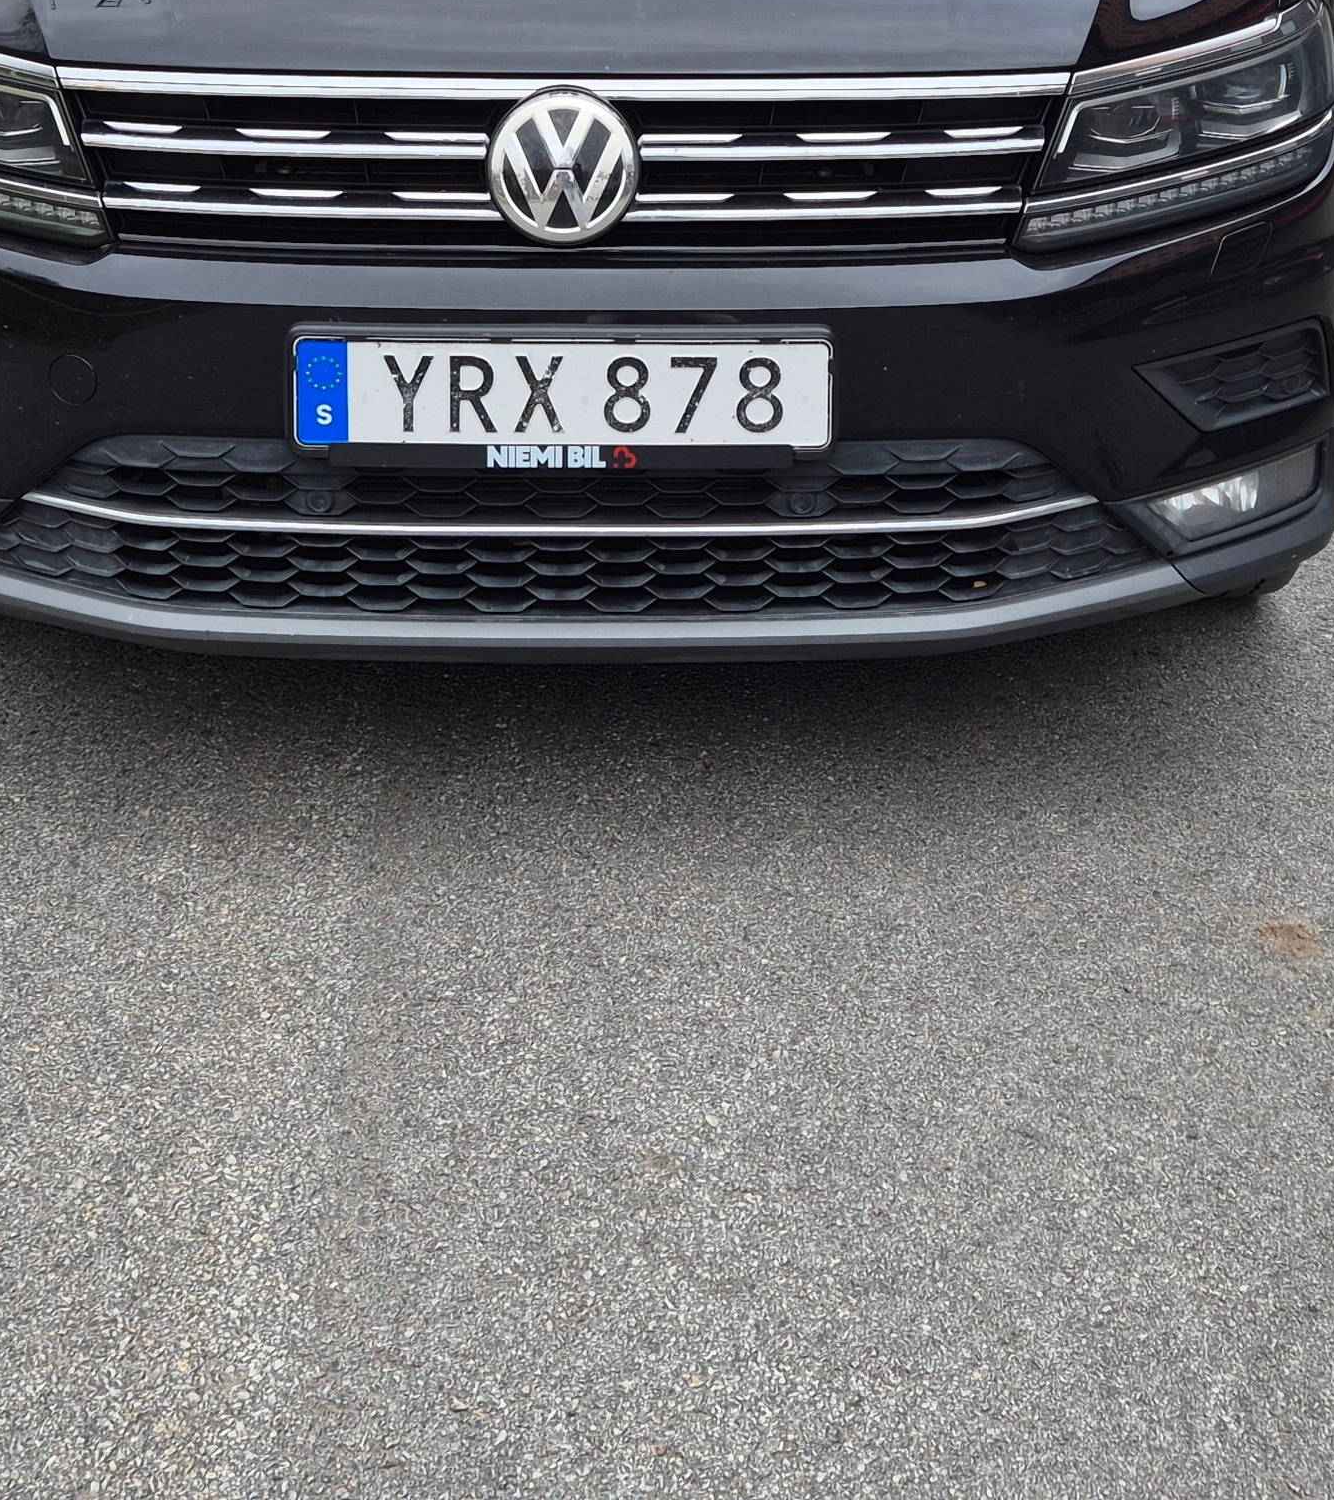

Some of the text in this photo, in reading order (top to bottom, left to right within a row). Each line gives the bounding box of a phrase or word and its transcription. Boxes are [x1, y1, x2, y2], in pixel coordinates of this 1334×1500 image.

[493, 96, 634, 242] VW
[316, 404, 333, 425] S
[383, 354, 784, 434] YRX 878
[486, 445, 607, 468] NIEMI BIL
